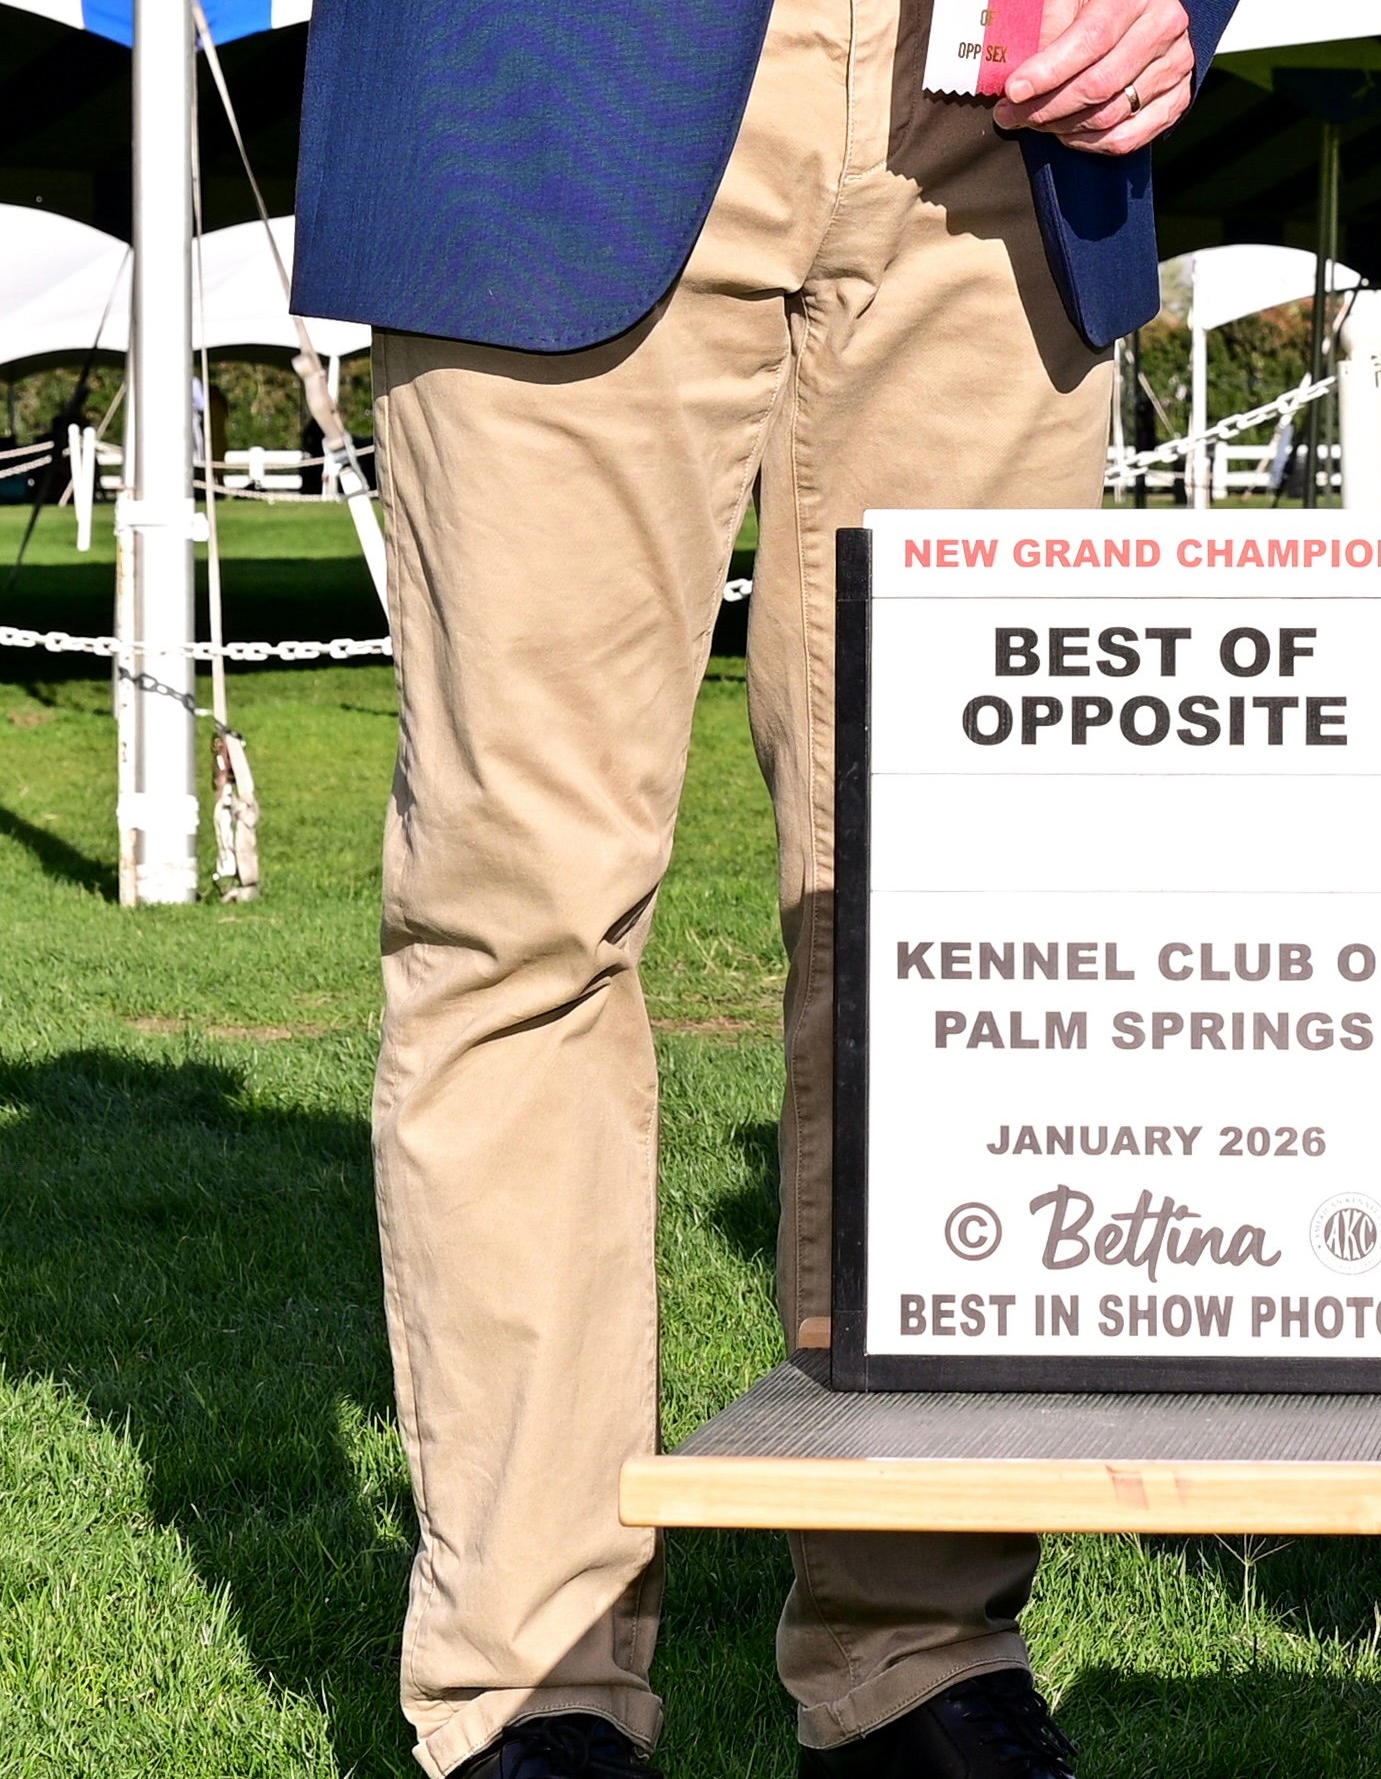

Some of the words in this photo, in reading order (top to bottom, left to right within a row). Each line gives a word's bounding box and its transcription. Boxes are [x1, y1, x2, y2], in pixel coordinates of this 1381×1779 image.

[957, 41, 982, 59] OPP
[985, 45, 1008, 63] SEX
[904, 538, 999, 568] NEW
[1012, 538, 1161, 568] GRAND
[994, 626, 1193, 678] BEST
[1218, 626, 1318, 679] OF
[961, 694, 1348, 747] OPPOSITE
[896, 941, 1136, 981] KENNEL
[1157, 941, 1314, 982] CLUB
[934, 1010, 1088, 1050] PALM
[1111, 1010, 1374, 1052] SPRINGS
[986, 1124, 1203, 1156] JANUARY
[1218, 1126, 1327, 1157] 2026
[1028, 1183, 1282, 1284] Bettina
[1324, 1207, 1378, 1261] AKC
[900, 1293, 1017, 1338] BEST
[1034, 1294, 1080, 1337] IN
[1097, 1293, 1234, 1338] SHOW
